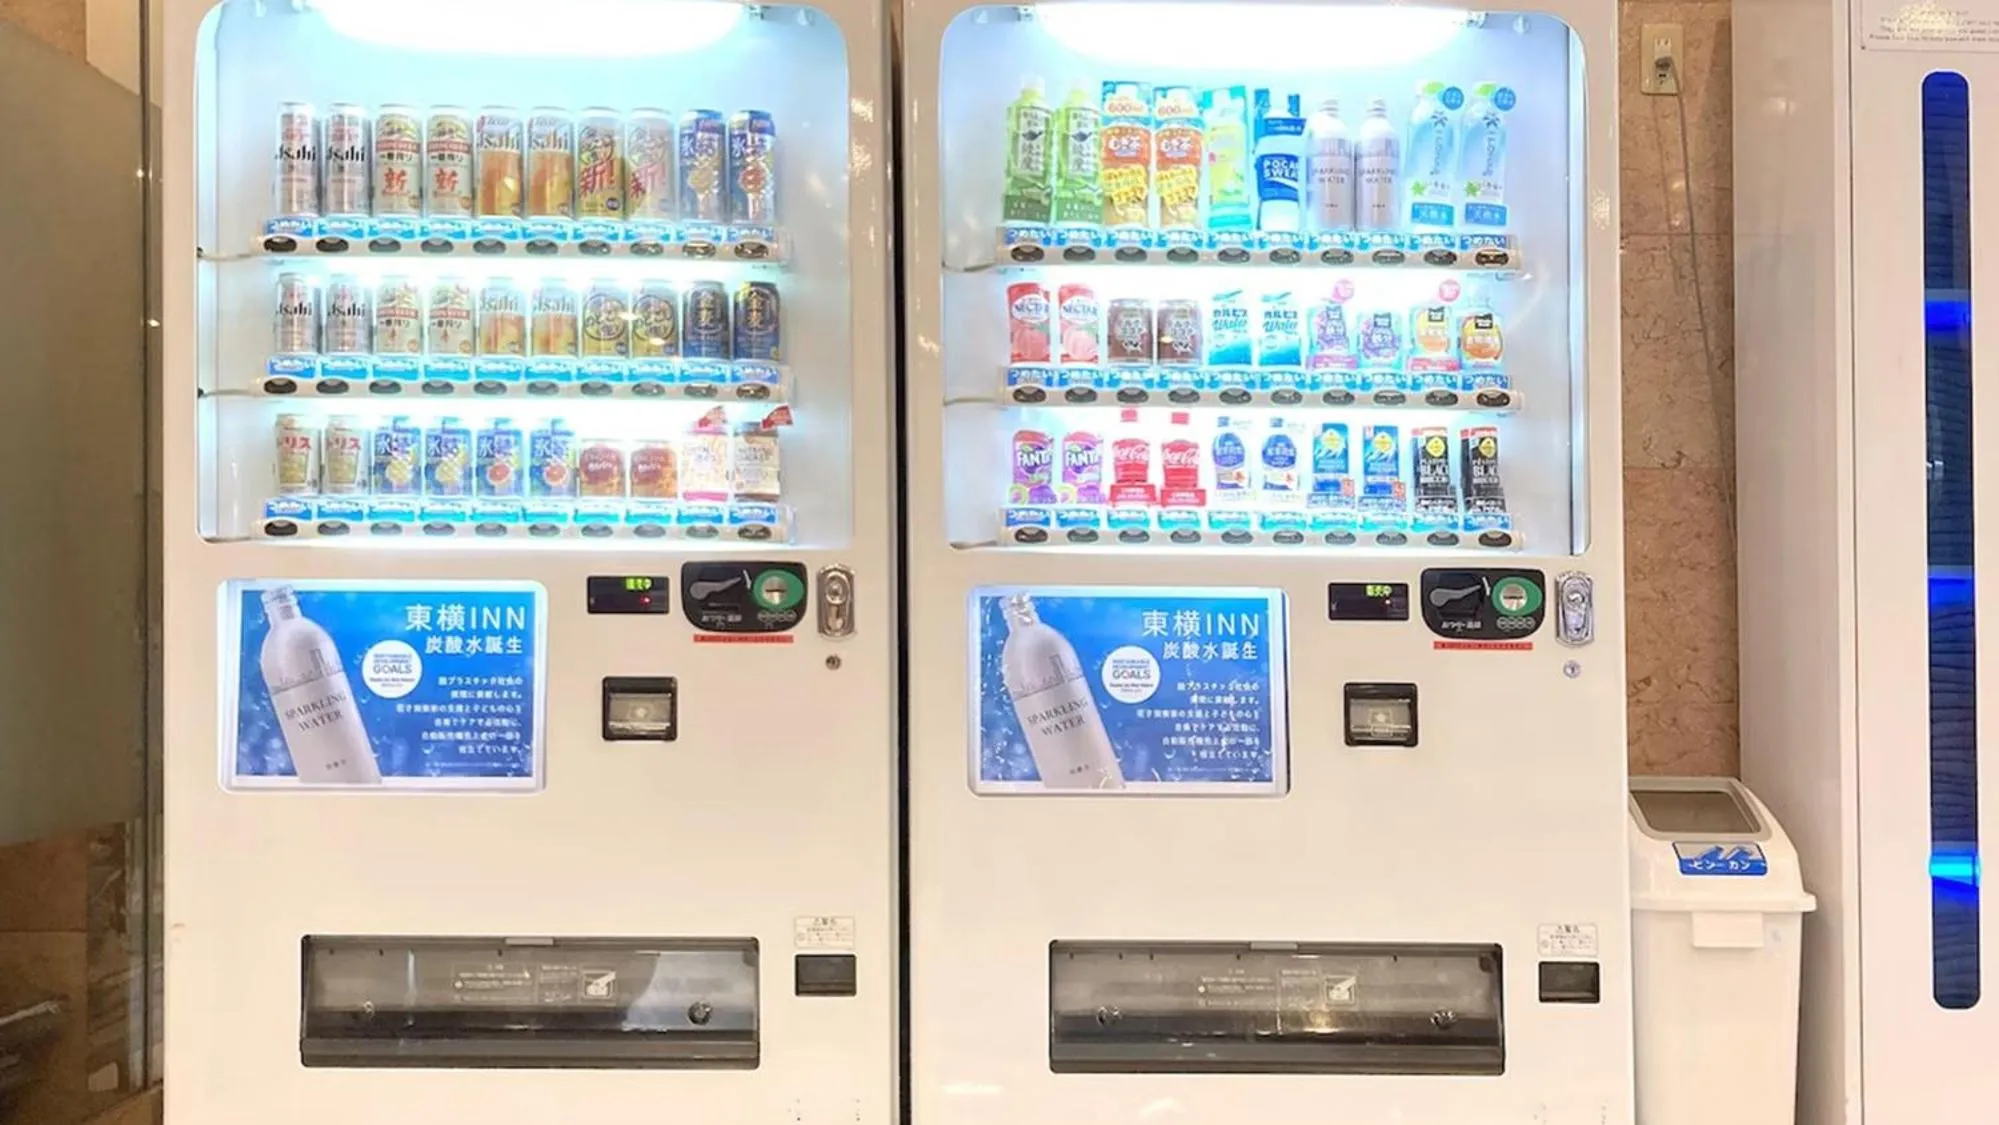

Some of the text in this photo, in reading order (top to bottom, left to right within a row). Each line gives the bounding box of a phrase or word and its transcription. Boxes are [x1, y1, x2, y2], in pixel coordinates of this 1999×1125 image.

[325, 144, 365, 162] Asahi
[405, 603, 526, 631] 東横INN
[1142, 610, 1260, 638] 東横INN
[425, 635, 524, 655] 炭酸水誕生
[1162, 640, 1259, 661] 炭酸水誕生
[372, 664, 413, 675] GOALS
[1111, 669, 1152, 680] GOALS
[298, 709, 342, 732] WATER
[1040, 714, 1086, 736] WATER
